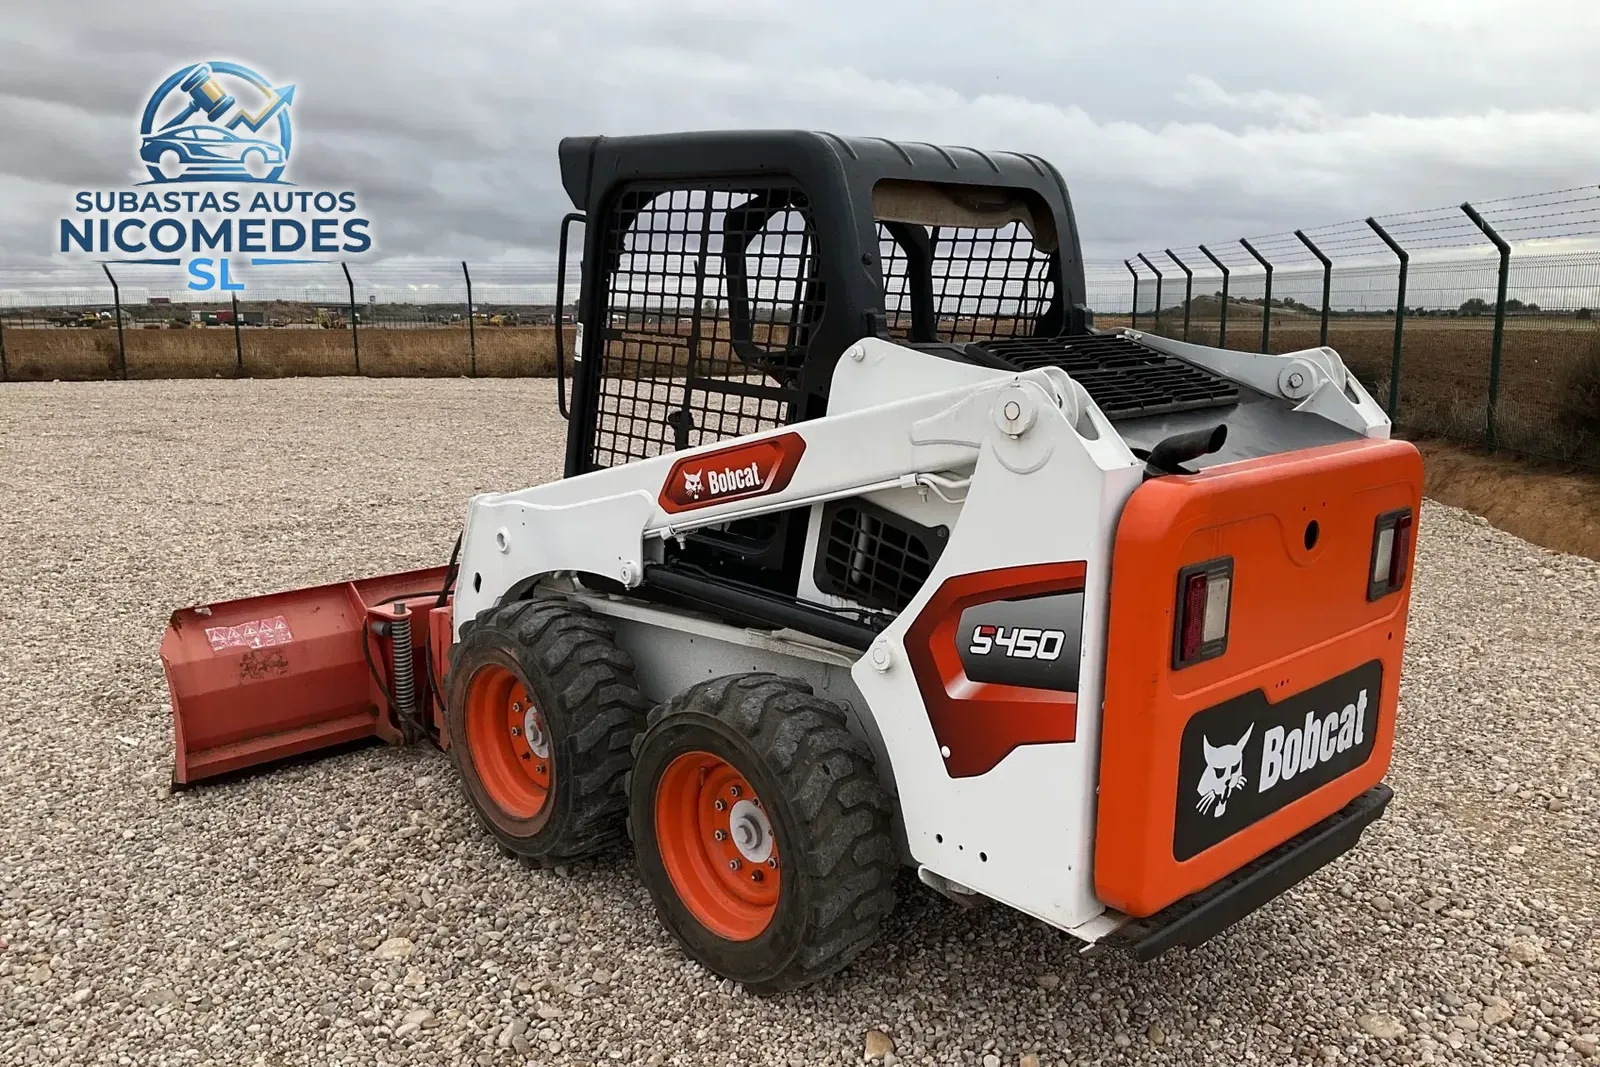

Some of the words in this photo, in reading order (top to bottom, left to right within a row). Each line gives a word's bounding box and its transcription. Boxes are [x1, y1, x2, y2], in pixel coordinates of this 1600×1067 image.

[707, 461, 761, 495] Bobcat
[969, 624, 1067, 661] S450
[1258, 688, 1368, 794] Bobcat
